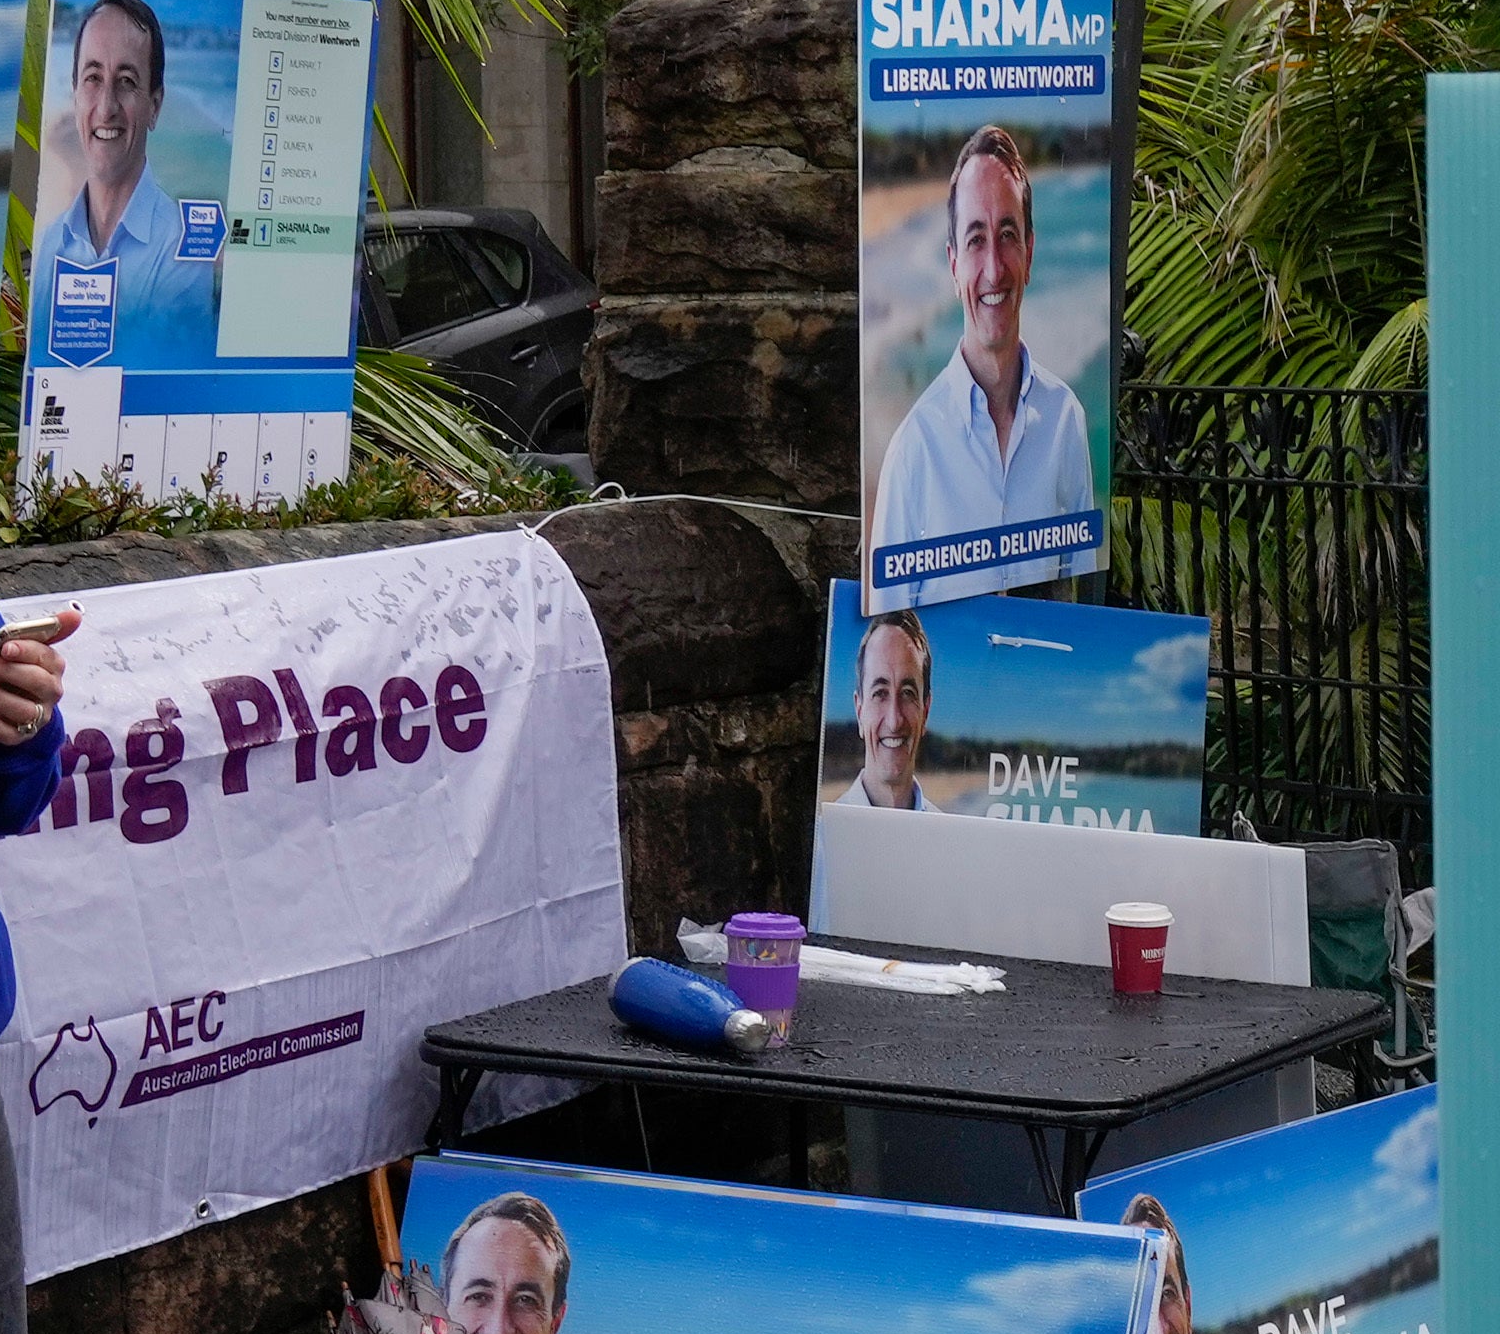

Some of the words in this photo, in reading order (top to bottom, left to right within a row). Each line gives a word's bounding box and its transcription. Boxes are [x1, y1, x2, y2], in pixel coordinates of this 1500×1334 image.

[295, 16, 319, 25] number
[1072, 14, 1105, 45] MP
[253, 28, 282, 41] Electoral
[284, 30, 310, 43] Division
[311, 34, 318, 43] of
[320, 34, 360, 47] Wentworth
[882, 67, 950, 93] LIBERAL
[954, 67, 986, 91] FOR
[990, 64, 1094, 90] WENTWORTH
[191, 209, 207, 220] Step
[313, 224, 330, 234] Dave
[73, 279, 90, 289] Step
[62, 292, 85, 301] Senate
[86, 292, 106, 303] Voting
[41, 379, 48, 389] G
[884, 542, 996, 578] EXPERIENCED.
[1000, 521, 1094, 556] DELIVERING.
[202, 665, 488, 795] Place
[988, 752, 1078, 798] DAVE
[140, 990, 227, 1060] AEC
[141, 1061, 218, 1097] Australian
[220, 1043, 277, 1074] Electoral
[281, 1020, 359, 1055] Commission
